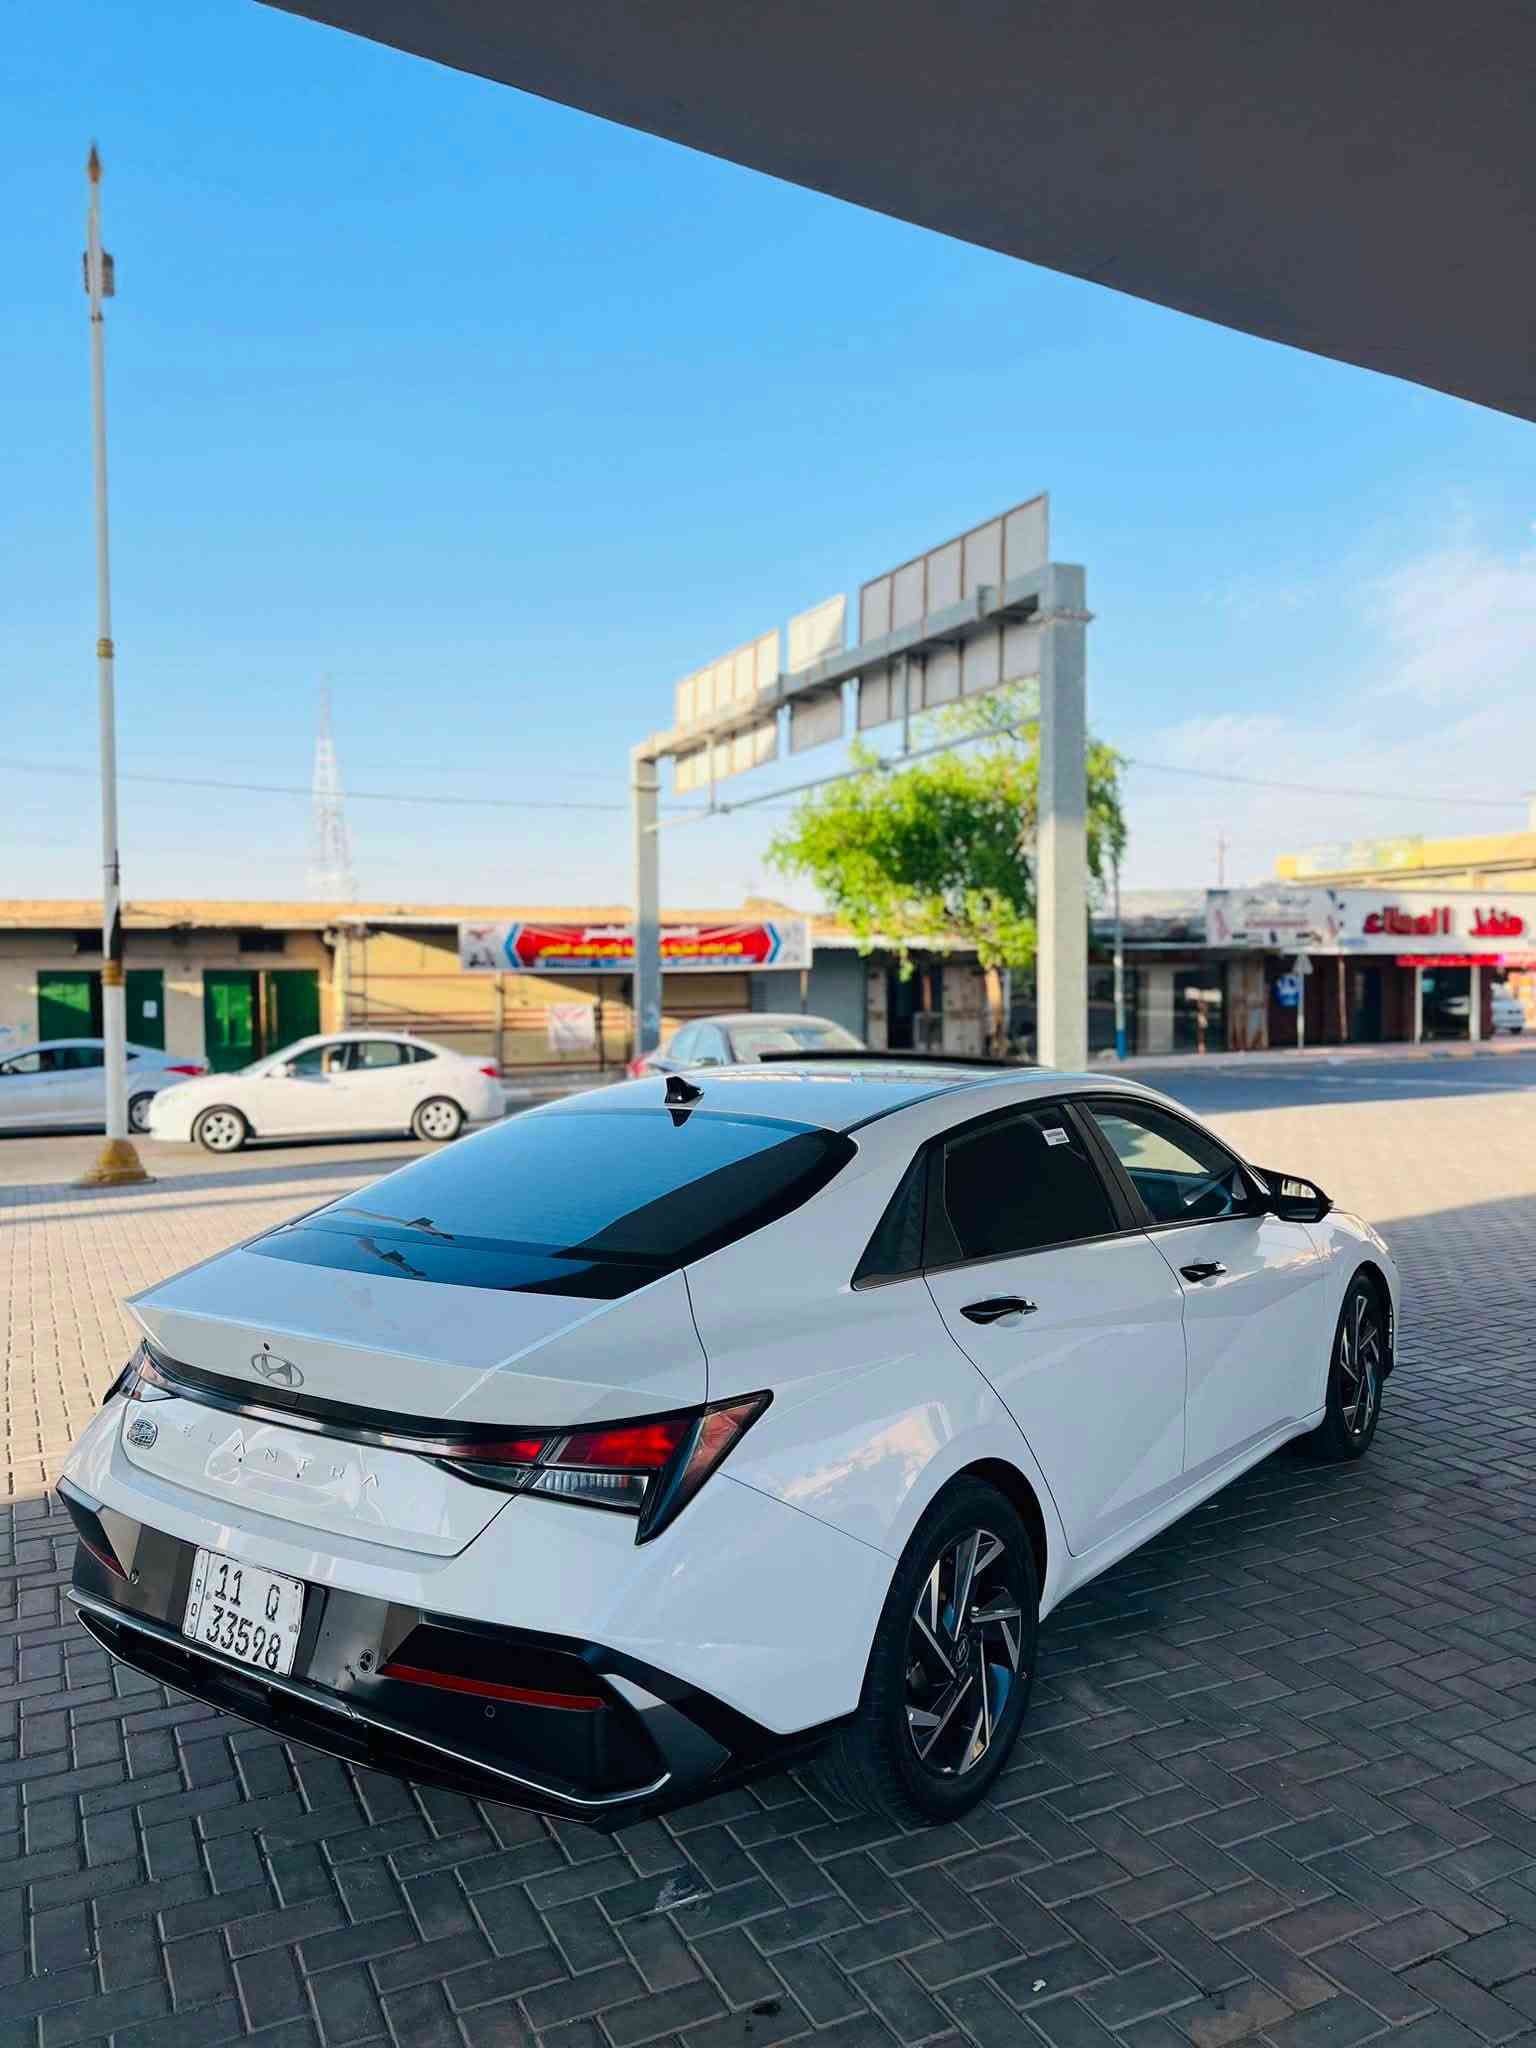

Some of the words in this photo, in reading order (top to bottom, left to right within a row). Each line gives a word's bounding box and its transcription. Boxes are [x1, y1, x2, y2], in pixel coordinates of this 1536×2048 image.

[184, 1423, 380, 1488] ELANTRA
[215, 1564, 242, 1606] 11
[265, 1584, 281, 1621] Q
[206, 1603, 281, 1670] 33598
